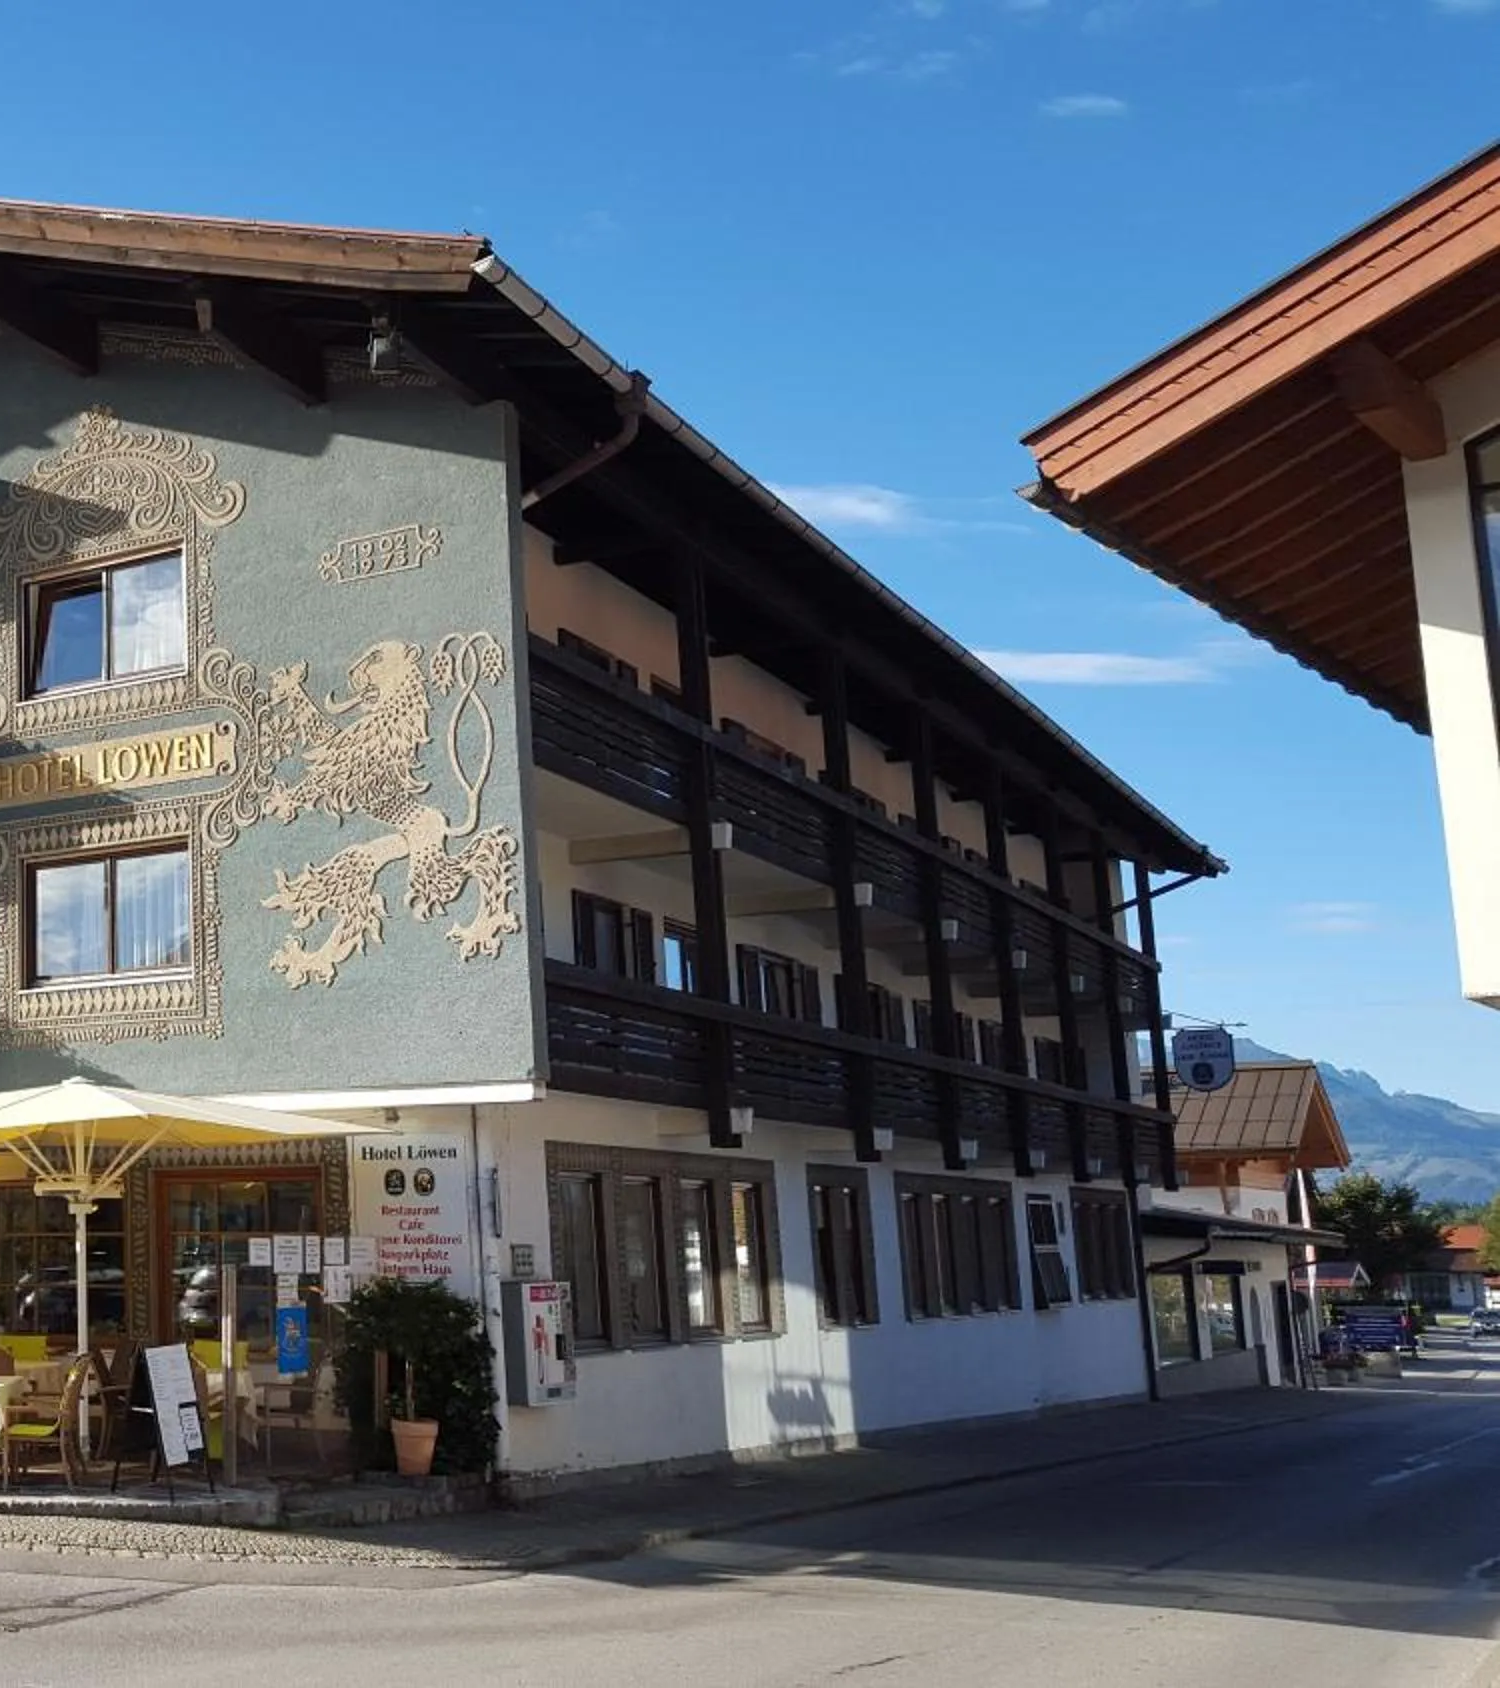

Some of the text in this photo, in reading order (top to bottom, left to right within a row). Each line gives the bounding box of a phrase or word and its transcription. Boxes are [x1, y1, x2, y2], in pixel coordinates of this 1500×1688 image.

[97, 731, 214, 785] LÖWEN
[361, 1145, 457, 1160] Hotel Löwen
[381, 1205, 440, 1216] Restaurant
[403, 1234, 463, 1245] Konditorei
[423, 1264, 452, 1275] Haus
